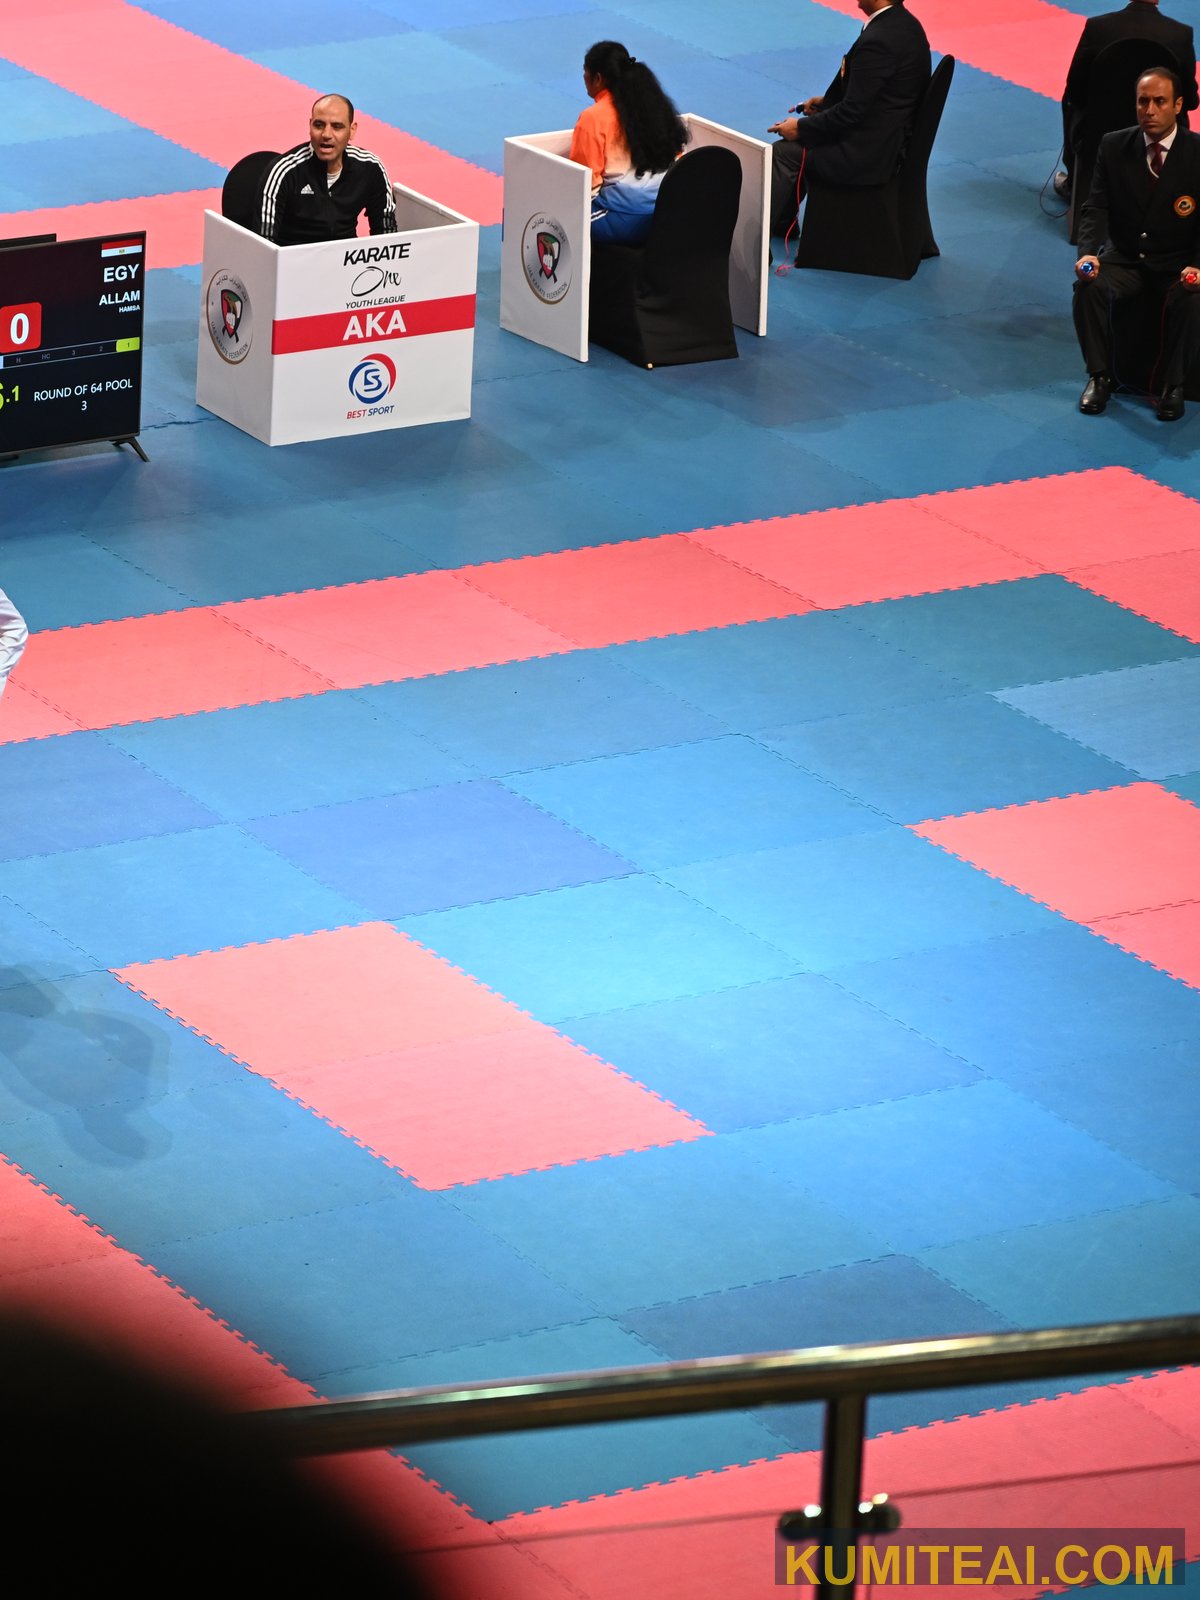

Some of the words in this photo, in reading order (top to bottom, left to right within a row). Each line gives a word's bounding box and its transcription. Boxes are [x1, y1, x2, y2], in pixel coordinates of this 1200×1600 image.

[343, 242, 411, 266] KARATE
[103, 263, 140, 283] EGY
[351, 266, 401, 297] One
[98, 290, 140, 306] ALLAM
[345, 299, 373, 309] YOUTH
[373, 294, 406, 305] LEAGUE
[118, 304, 140, 313] HAMSA
[9, 311, 29, 345] 0
[342, 309, 407, 341] AKA
[33, 386, 72, 402] ROUND
[74, 384, 88, 396] OF
[90, 382, 103, 394] 64
[105, 378, 133, 391] POOL
[81, 400, 88, 411] 3
[346, 409, 367, 420] BEST
[368, 405, 394, 417] SPORT
